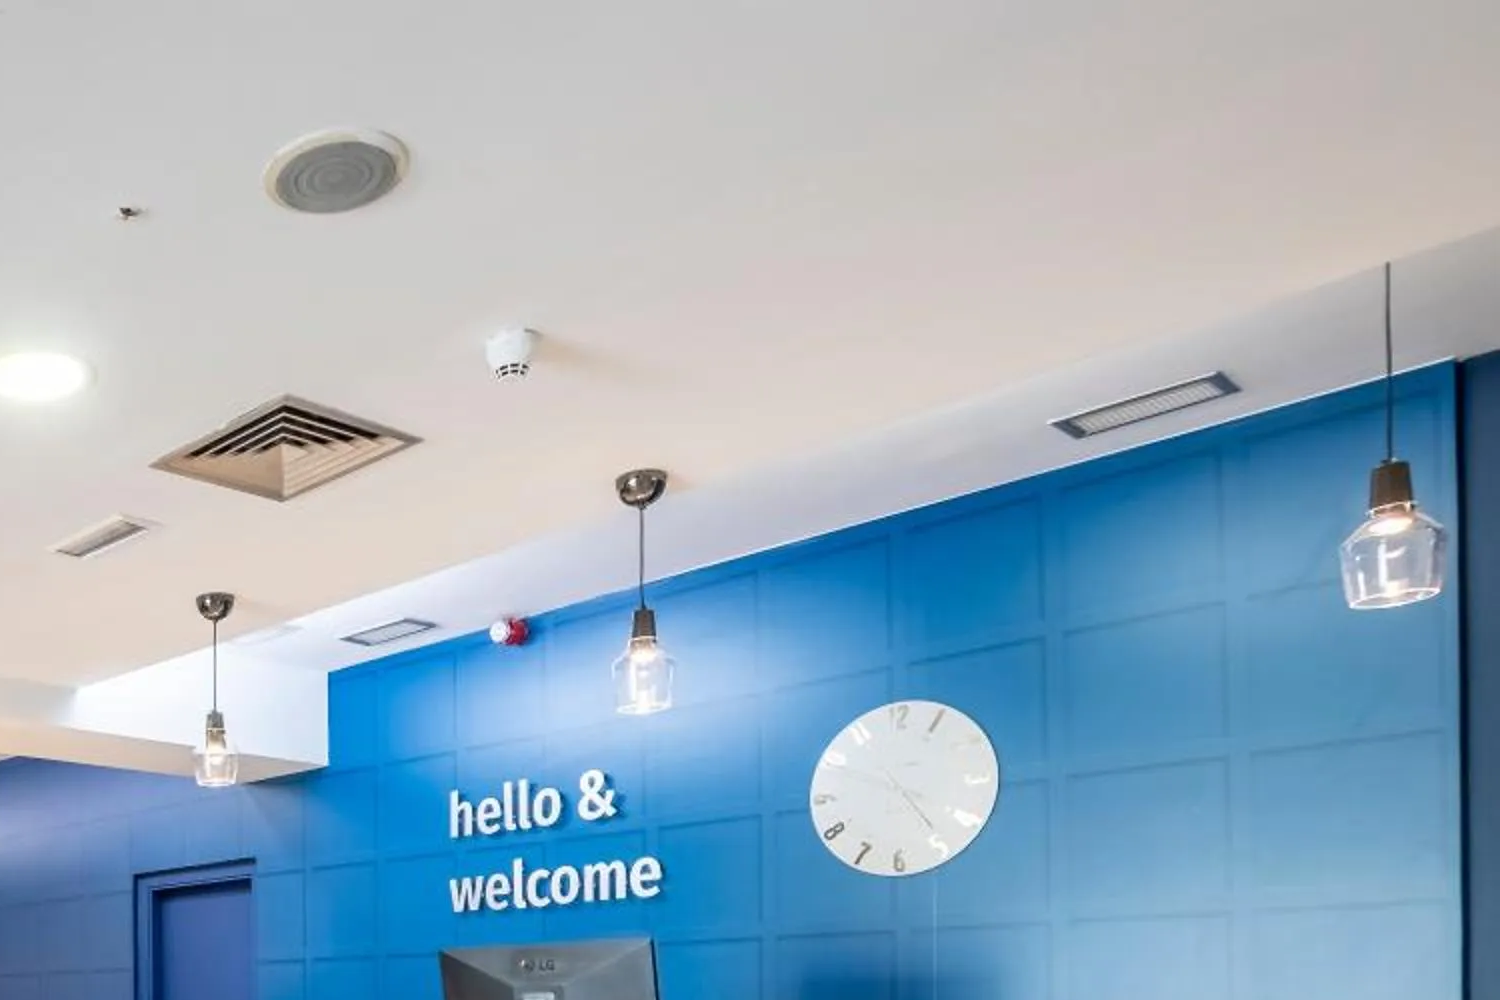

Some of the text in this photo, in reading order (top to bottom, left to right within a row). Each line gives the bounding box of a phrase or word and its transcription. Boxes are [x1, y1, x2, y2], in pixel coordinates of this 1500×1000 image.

[889, 704, 910, 730] 12
[450, 768, 618, 838] hello &
[823, 821, 846, 841] 8
[854, 841, 873, 866] 7
[893, 850, 906, 873] 6
[450, 856, 663, 913] welcome
[539, 958, 555, 971] LG
